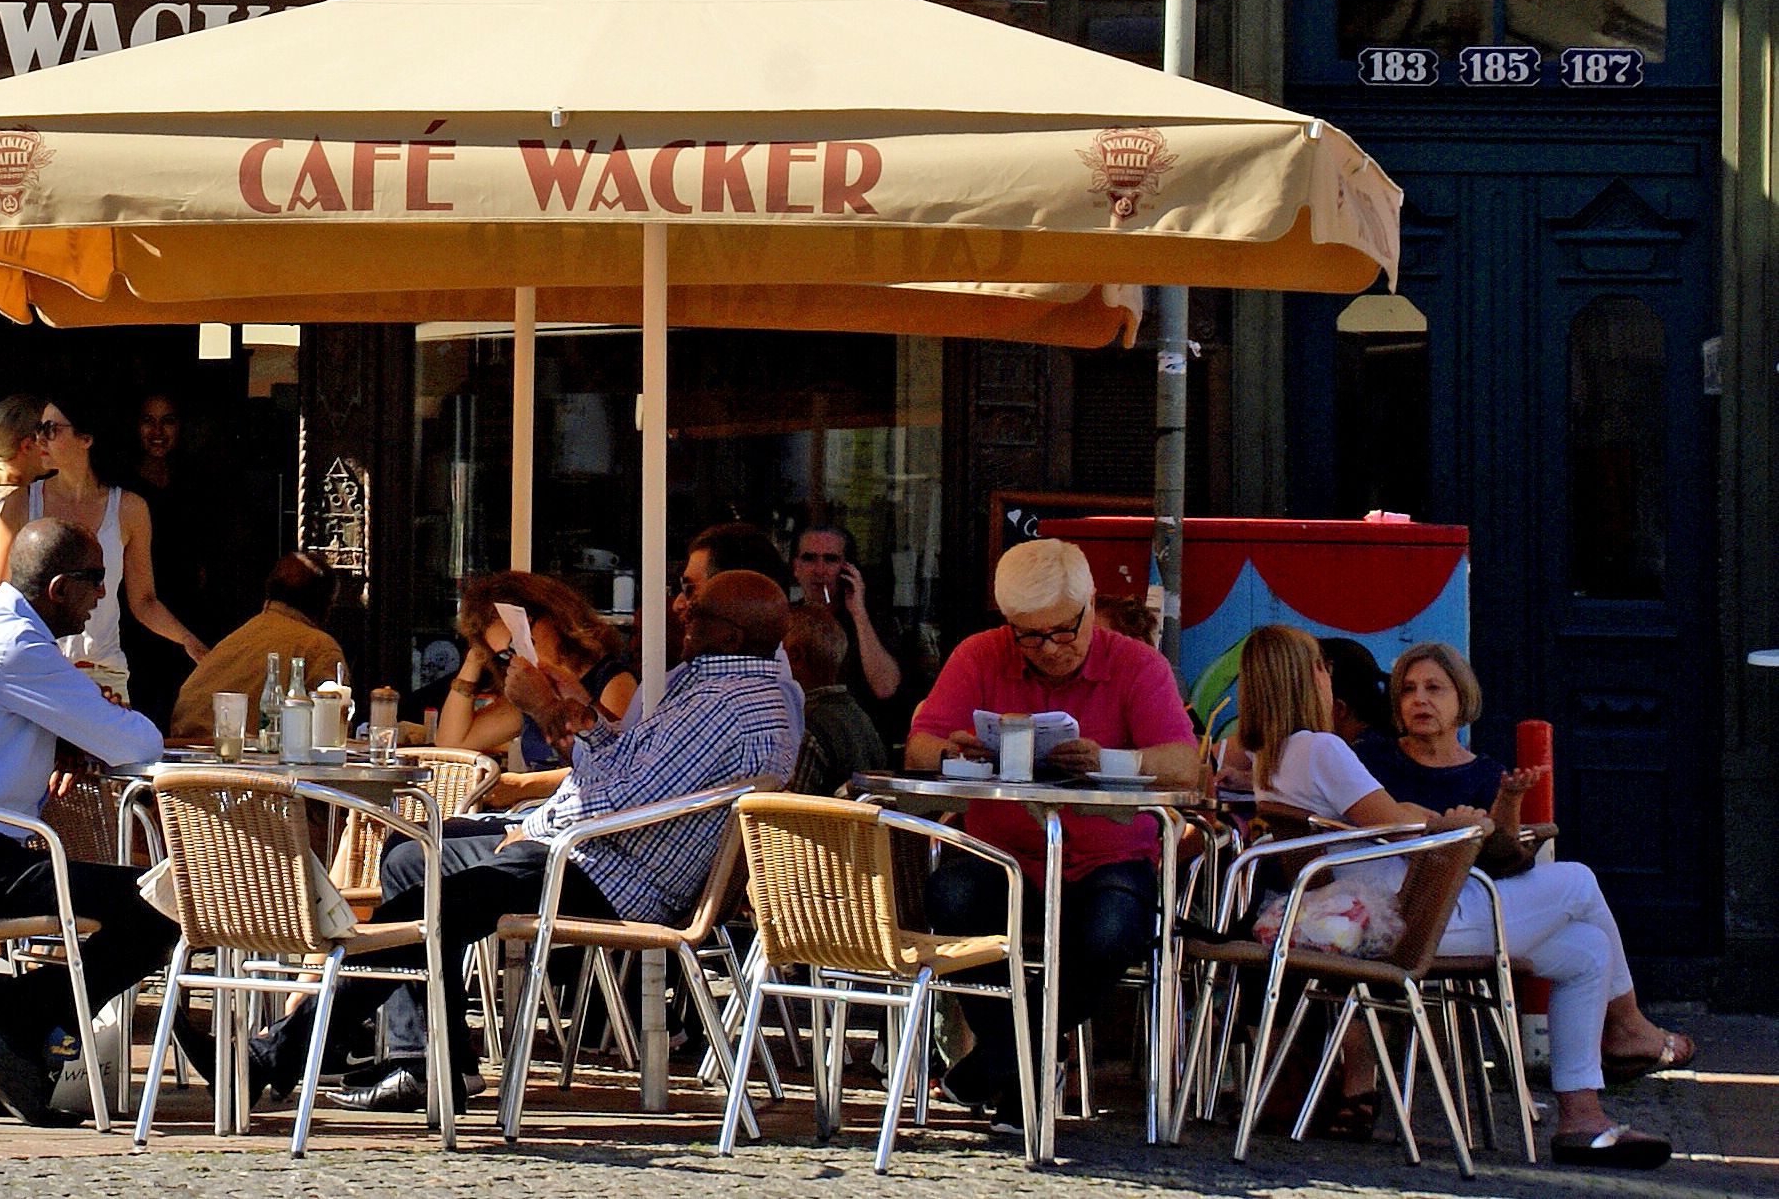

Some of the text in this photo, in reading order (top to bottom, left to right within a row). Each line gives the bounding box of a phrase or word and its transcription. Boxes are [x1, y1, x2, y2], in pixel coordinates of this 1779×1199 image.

[1370, 52, 1632, 83] 183 185 187
[238, 119, 882, 215] CAFÉ WACKER
